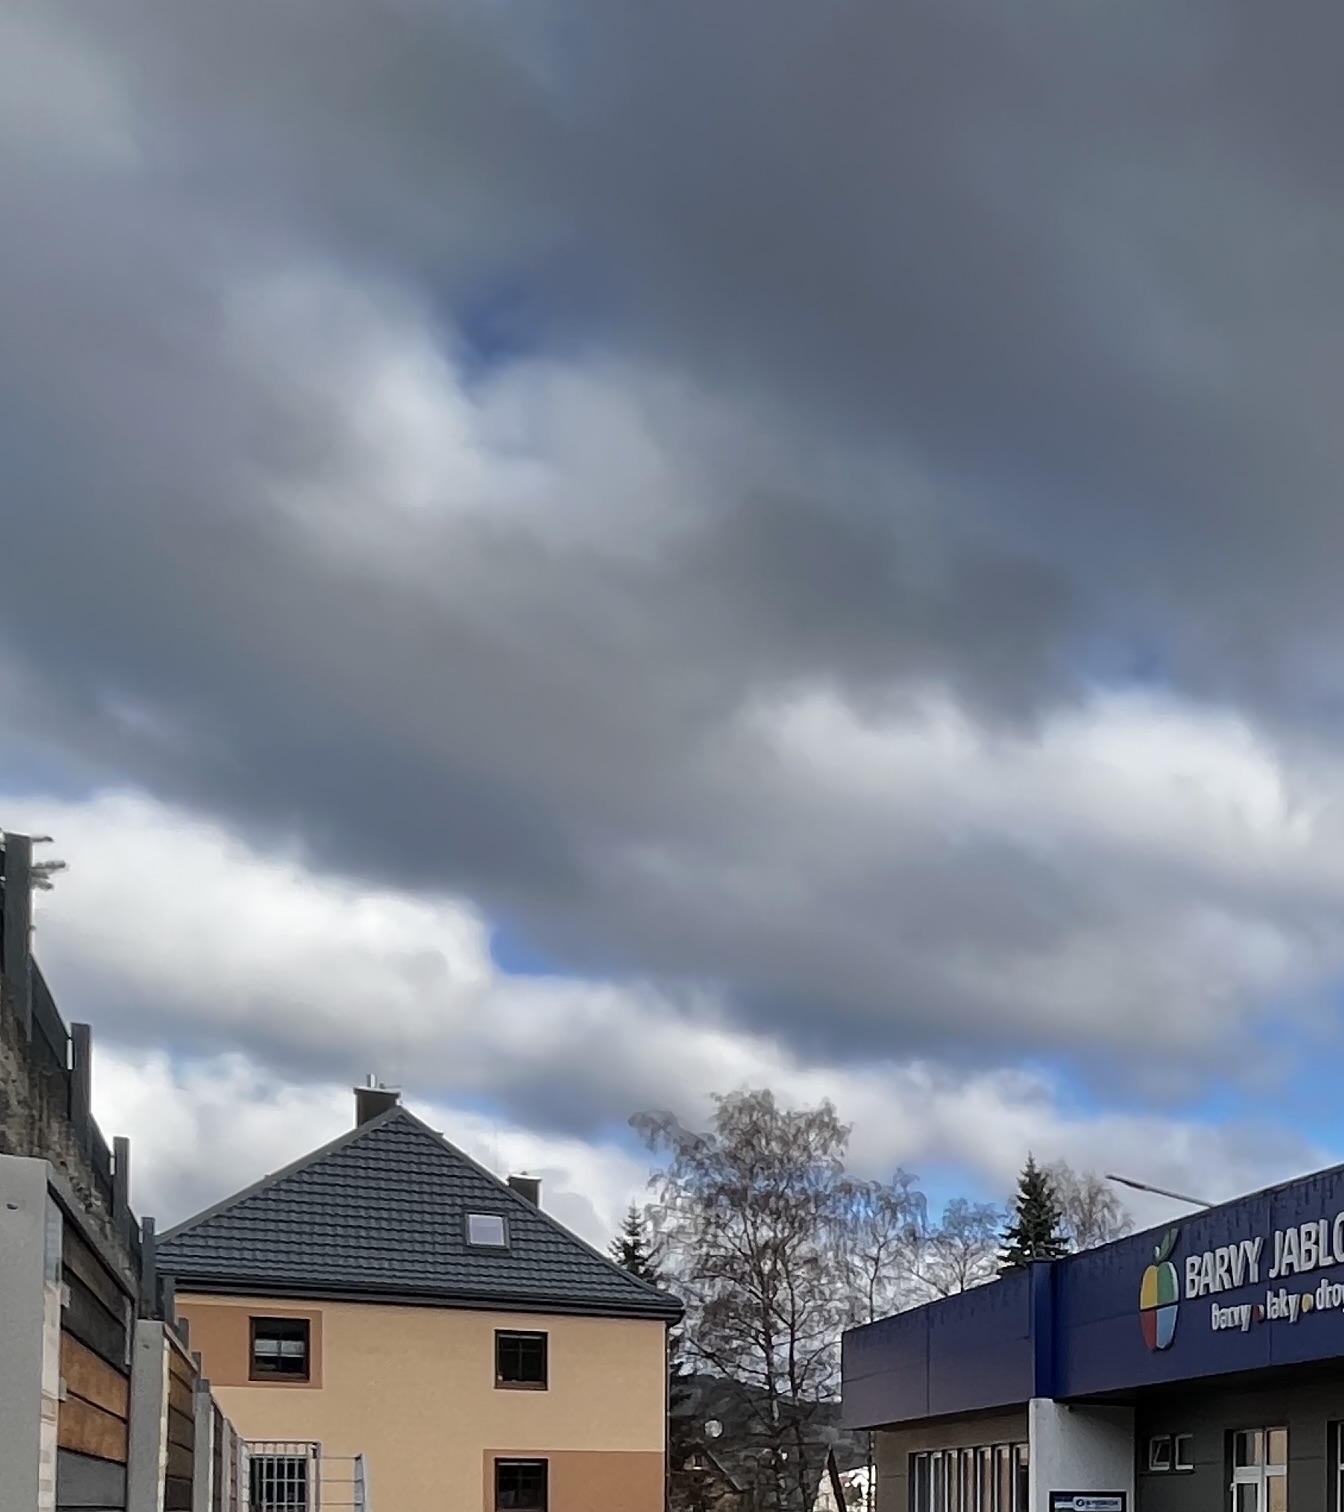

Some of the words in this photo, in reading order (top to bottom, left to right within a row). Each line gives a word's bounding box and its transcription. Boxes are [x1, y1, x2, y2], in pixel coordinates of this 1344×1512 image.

[1185, 1237, 1264, 1299] BARVY
[1211, 1302, 1251, 1331] barvy
[1266, 1289, 1300, 1323] laky
